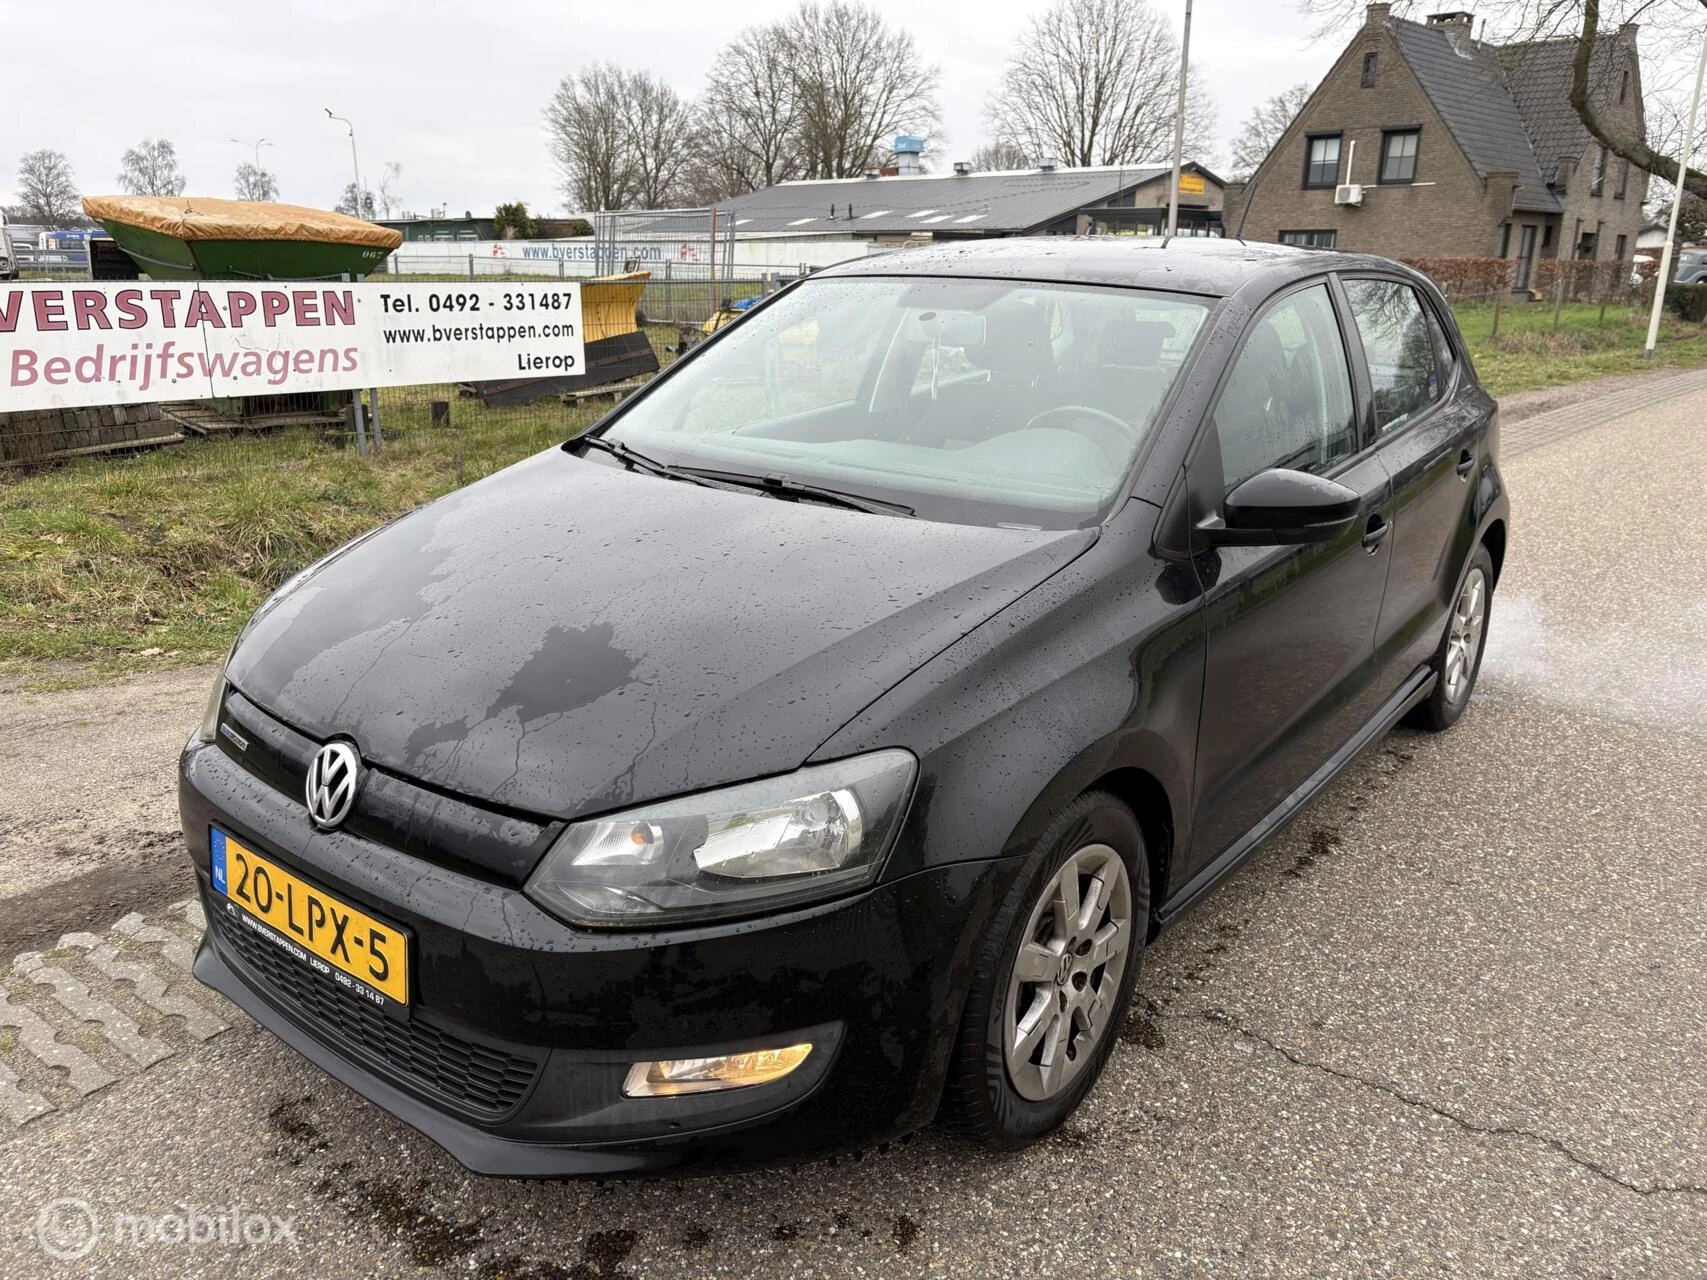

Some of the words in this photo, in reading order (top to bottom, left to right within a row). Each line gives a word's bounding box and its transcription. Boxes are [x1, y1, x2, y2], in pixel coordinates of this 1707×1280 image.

[362, 250, 384, 260] 067
[0, 289, 356, 332] VERSTAPPEN
[380, 294, 420, 313] Tel.
[429, 293, 480, 312] 0492
[503, 293, 572, 311] 331487
[383, 323, 574, 344] www.bverstappen.com
[10, 341, 358, 391] Bedrijfswagens
[518, 353, 575, 371] Lierop
[215, 865, 226, 885] NL
[236, 852, 390, 983] 20-LPX-5
